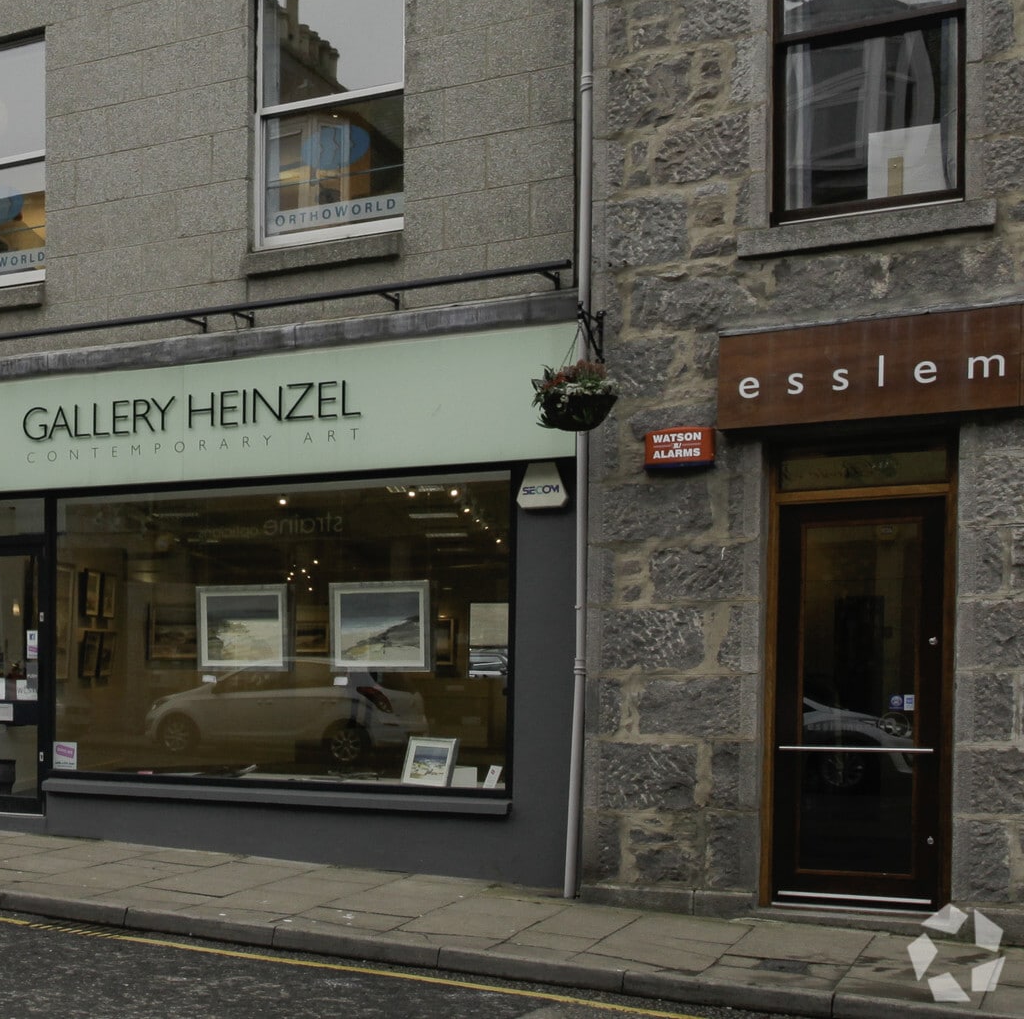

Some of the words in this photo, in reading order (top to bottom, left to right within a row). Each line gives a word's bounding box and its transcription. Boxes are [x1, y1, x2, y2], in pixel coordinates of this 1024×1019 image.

[738, 353, 1006, 399] esslem
[22, 395, 176, 442] GALLERY
[187, 379, 362, 430] HEINZEL
[26, 434, 272, 463] CONTEMPORARY
[304, 427, 361, 445] ART
[652, 431, 702, 444] WATSON
[652, 447, 701, 460] ALARMS
[522, 484, 560, 496] SECOM
